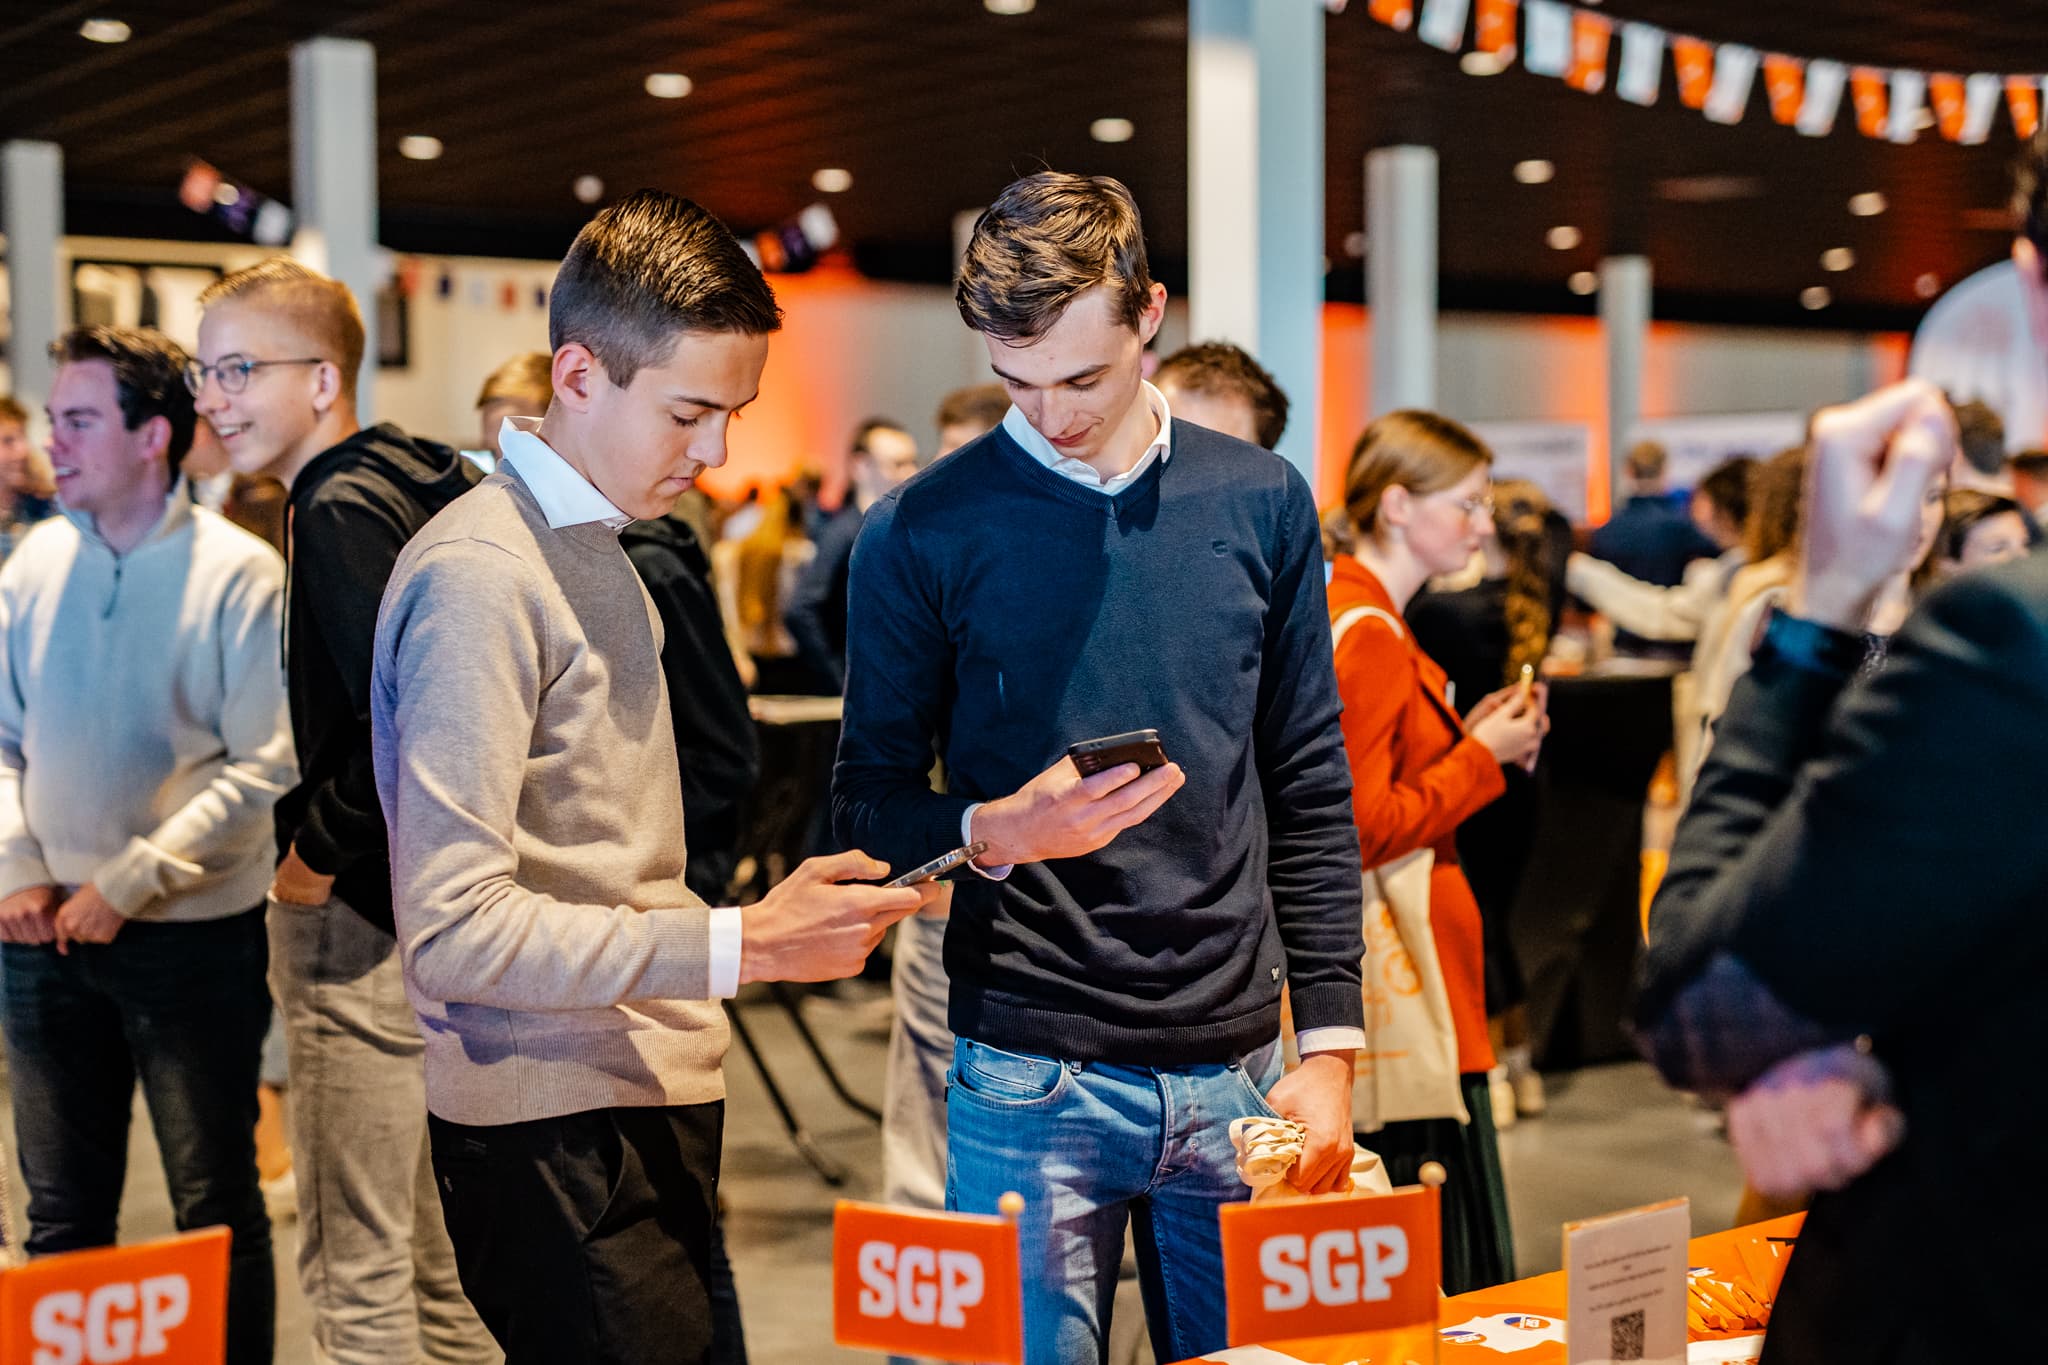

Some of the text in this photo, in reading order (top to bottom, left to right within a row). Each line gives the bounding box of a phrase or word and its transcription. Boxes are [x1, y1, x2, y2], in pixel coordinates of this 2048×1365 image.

[858, 1240, 985, 1329] SGP
[1259, 1225, 1409, 1312] SGP
[31, 1273, 190, 1365] SGP
